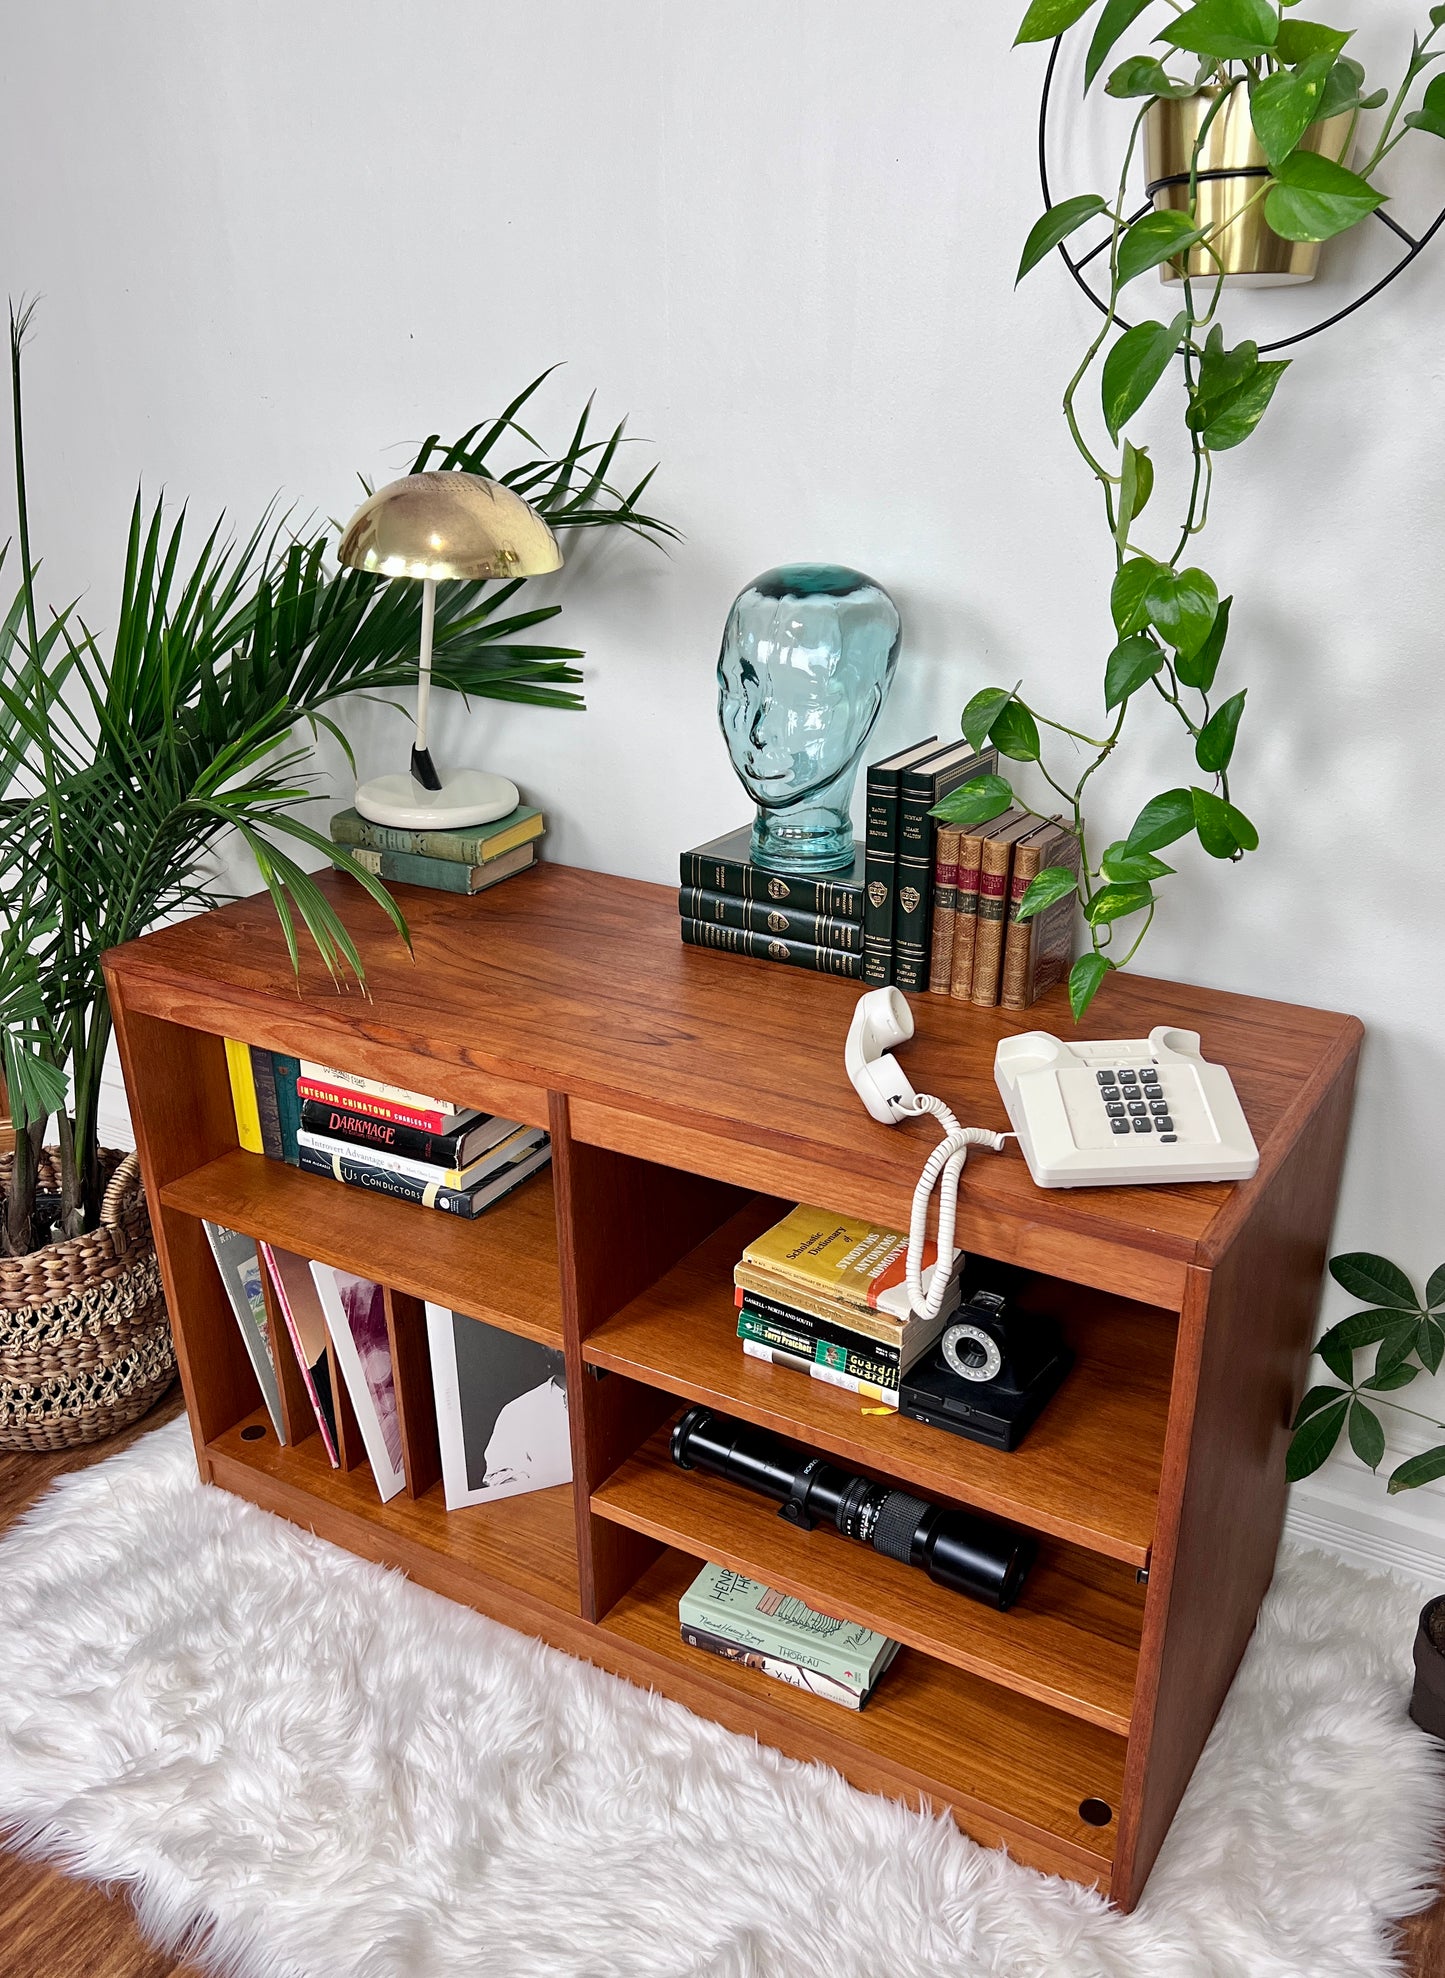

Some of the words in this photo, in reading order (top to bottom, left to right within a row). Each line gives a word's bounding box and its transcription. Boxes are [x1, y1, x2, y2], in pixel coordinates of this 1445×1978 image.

[300, 1085, 339, 1104] INTERIOR
[342, 1096, 391, 1118] CHINATOWN
[394, 1113, 422, 1127] CHARLES
[423, 1121, 432, 1129] YU
[329, 1112, 396, 1145] DARKMAGE
[311, 1137, 344, 1155] Introvert
[345, 1147, 386, 1167] Advantage
[786, 1231, 824, 1260] Scholastic
[808, 1226, 847, 1256] Dictionary
[835, 1232, 880, 1270] SYNONYMS
[844, 1235, 853, 1244] of
[853, 1234, 897, 1274] ANTONYMS
[867, 1236, 910, 1278] HOMONYMS
[744, 1296, 765, 1309] GASKELL
[767, 1305, 785, 1317] NORTH
[785, 1312, 797, 1321] AND
[796, 1316, 814, 1328] SOUTH
[764, 1329, 782, 1343] Terry
[781, 1335, 812, 1354] Pratchett
[849, 1364, 895, 1388] Guards!
[850, 1355, 896, 1377] Guards!
[709, 1568, 736, 1602] HENR
[778, 1645, 822, 1668] THOREAU
[775, 1670, 800, 1687] PAX
